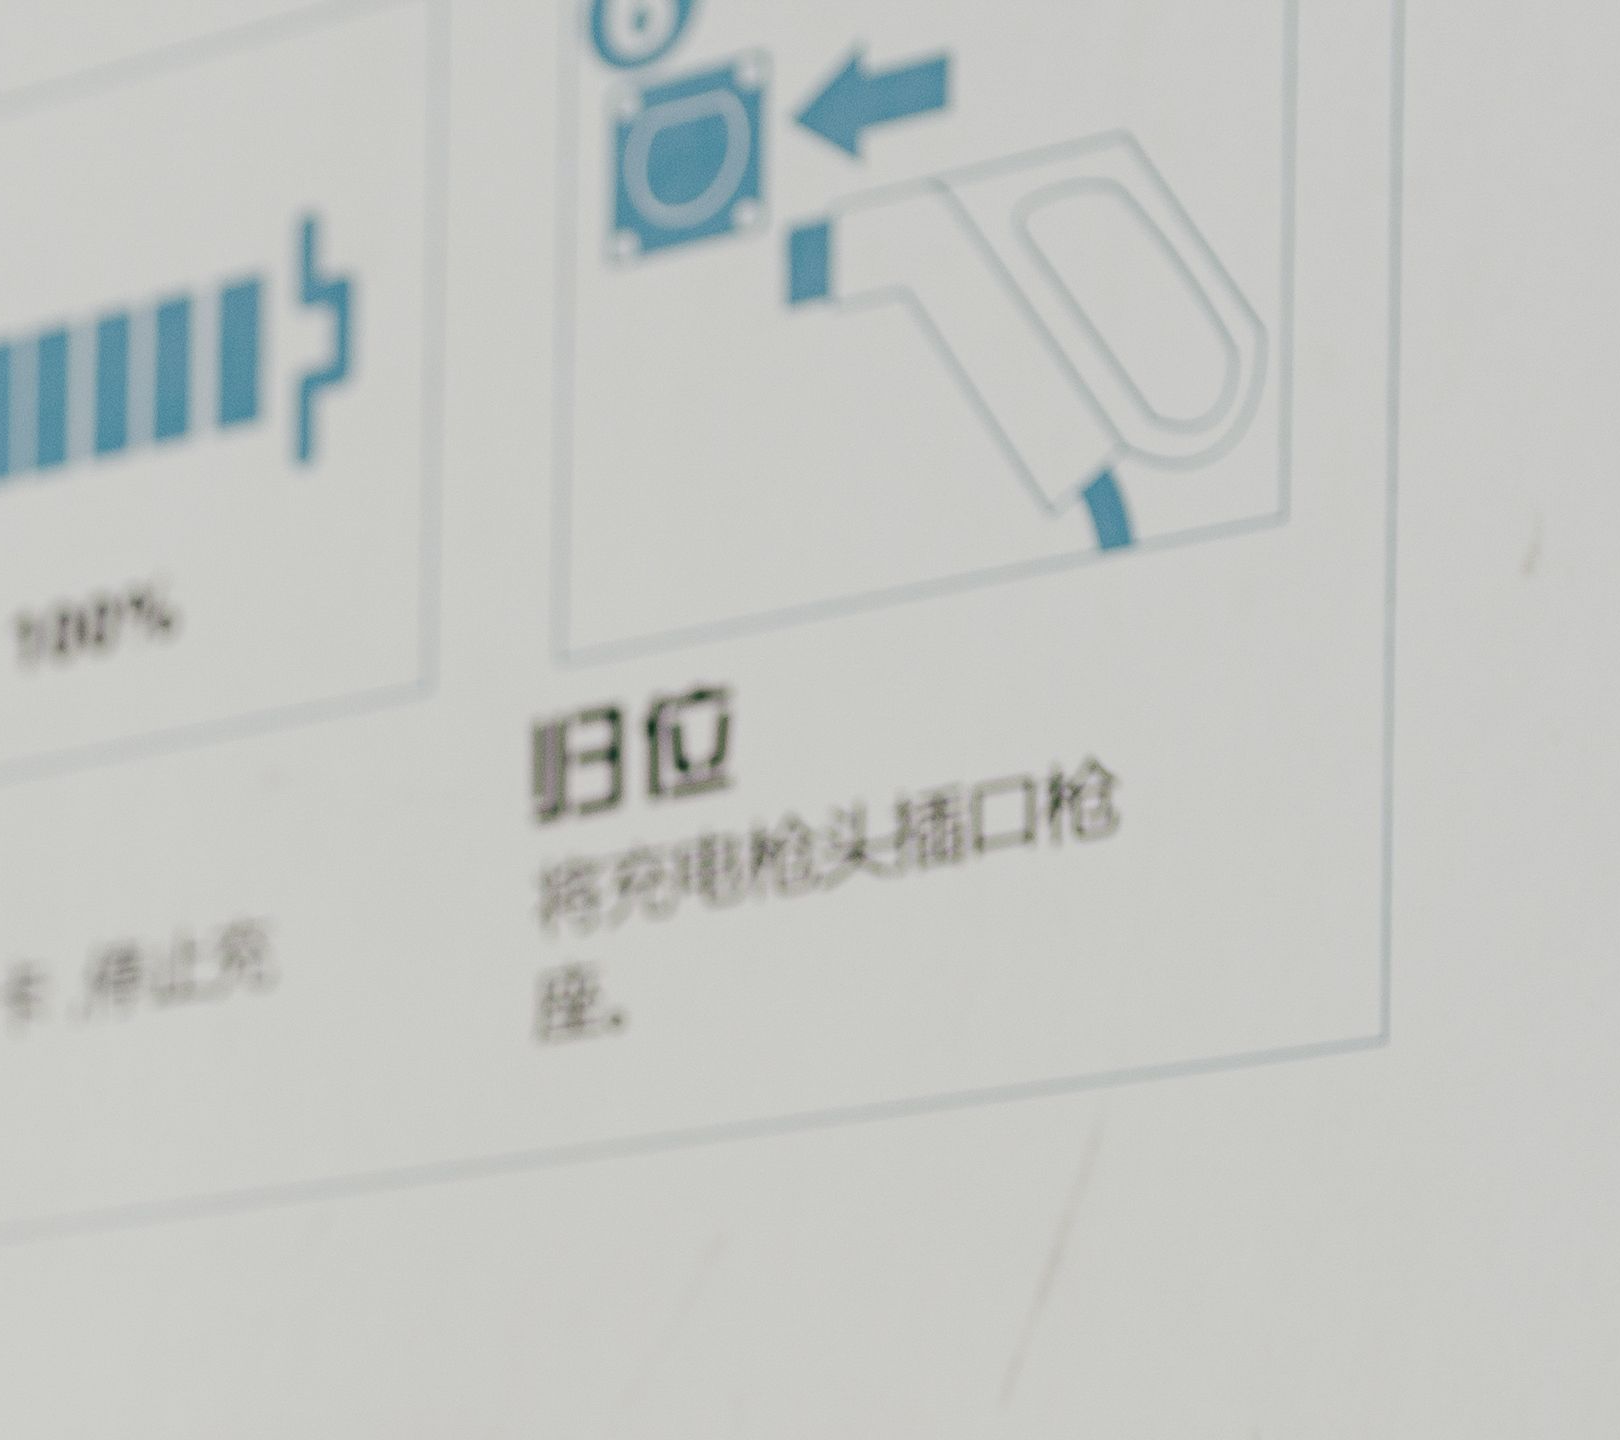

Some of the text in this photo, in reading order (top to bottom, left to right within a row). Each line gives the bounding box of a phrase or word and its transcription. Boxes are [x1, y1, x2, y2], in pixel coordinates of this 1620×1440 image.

[530, 684, 737, 824] 归位
[537, 756, 1126, 936] 将充电枪头插口枪
